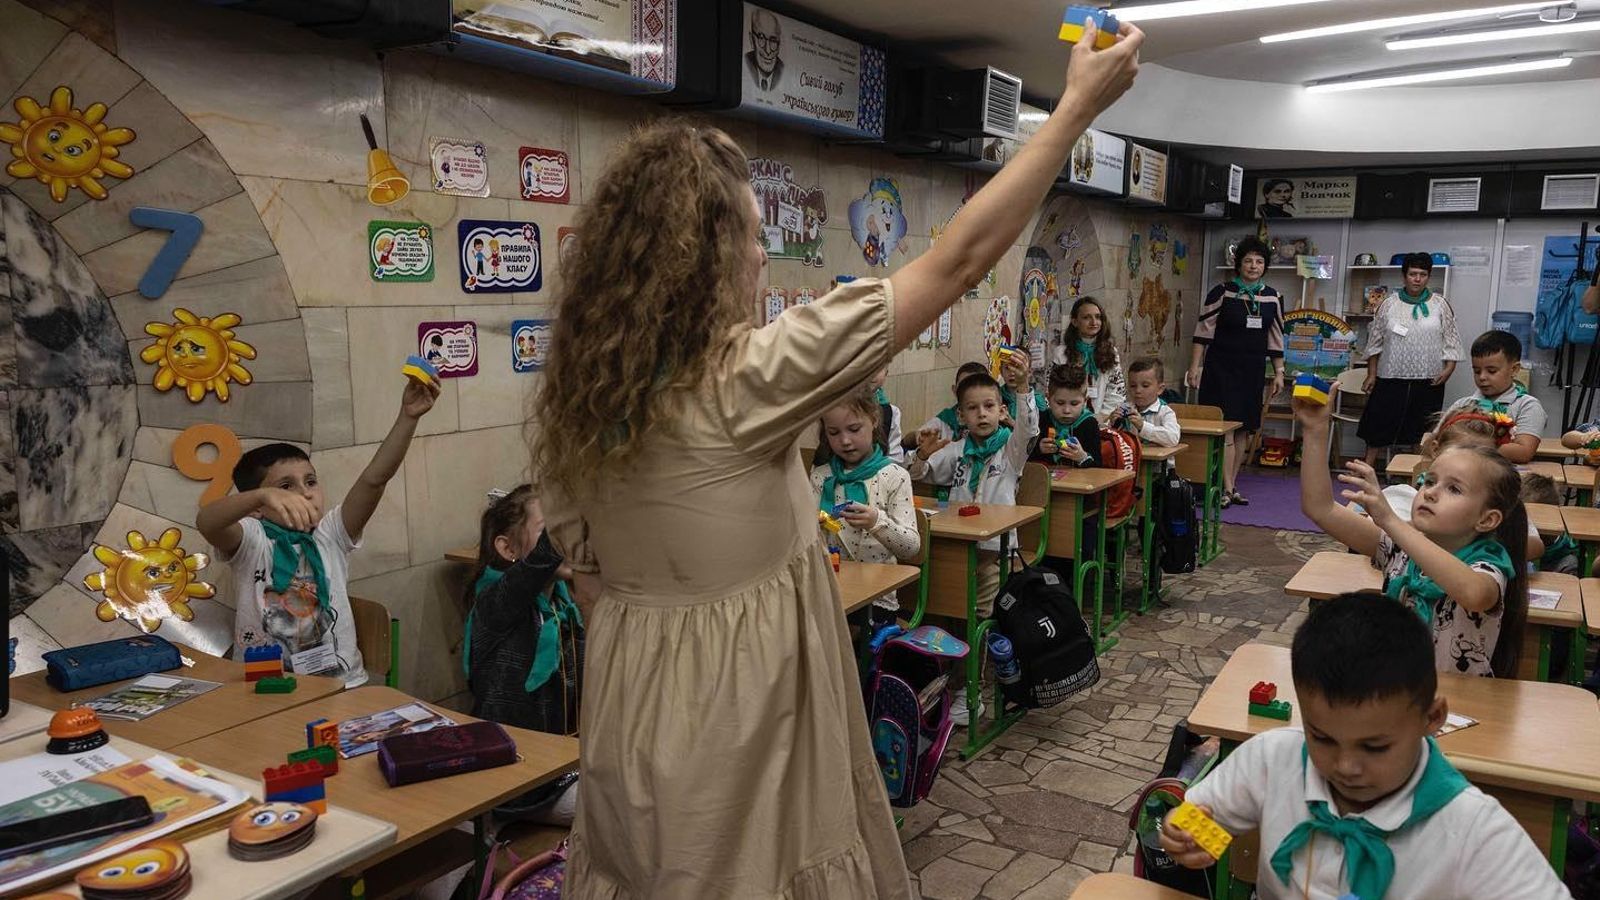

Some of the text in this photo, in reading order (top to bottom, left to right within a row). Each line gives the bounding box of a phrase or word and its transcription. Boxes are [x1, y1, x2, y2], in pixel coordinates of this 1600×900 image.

[750, 161, 780, 178] РКАН
[1304, 181, 1349, 190] Марко
[1300, 191, 1351, 199] Вовчок
[129, 206, 204, 300] 7
[501, 244, 532, 253] ПРАВИЛА
[507, 265, 529, 273] КЛАСУ
[1284, 312, 1308, 321] КОВІ
[1312, 311, 1350, 336] НОВИНИ
[172, 423, 242, 509] 9
[33, 793, 80, 815] БУ
[1155, 856, 1174, 867] BU
